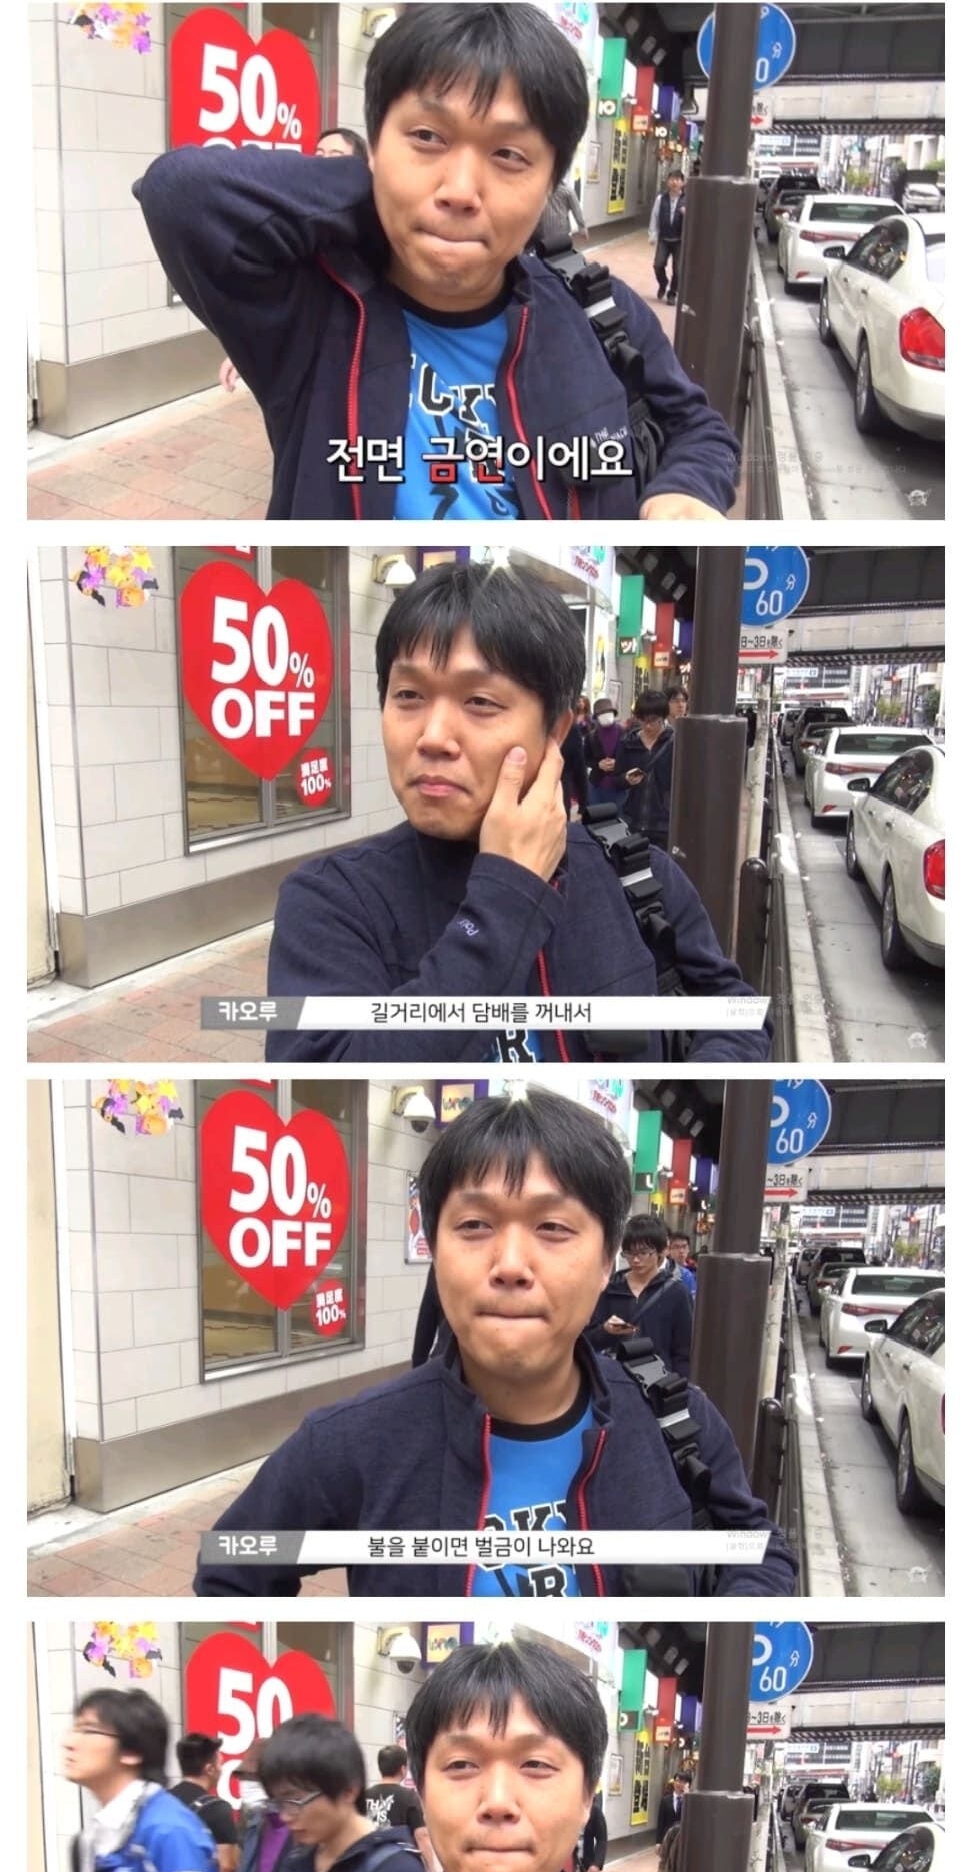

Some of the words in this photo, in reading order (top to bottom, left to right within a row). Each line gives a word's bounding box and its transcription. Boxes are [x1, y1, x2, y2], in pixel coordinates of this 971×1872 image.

[200, 43, 301, 140] 50%
[756, 590, 783, 616] 60
[211, 596, 315, 688] 50%
[211, 688, 315, 739] OFF
[301, 774, 331, 796] 100%
[775, 1128, 804, 1154] 60
[229, 1125, 332, 1219] 50%
[229, 1217, 332, 1268] OFF
[315, 1304, 346, 1326] 100%
[759, 1666, 787, 1692] 60
[216, 1667, 293, 1755] 50
